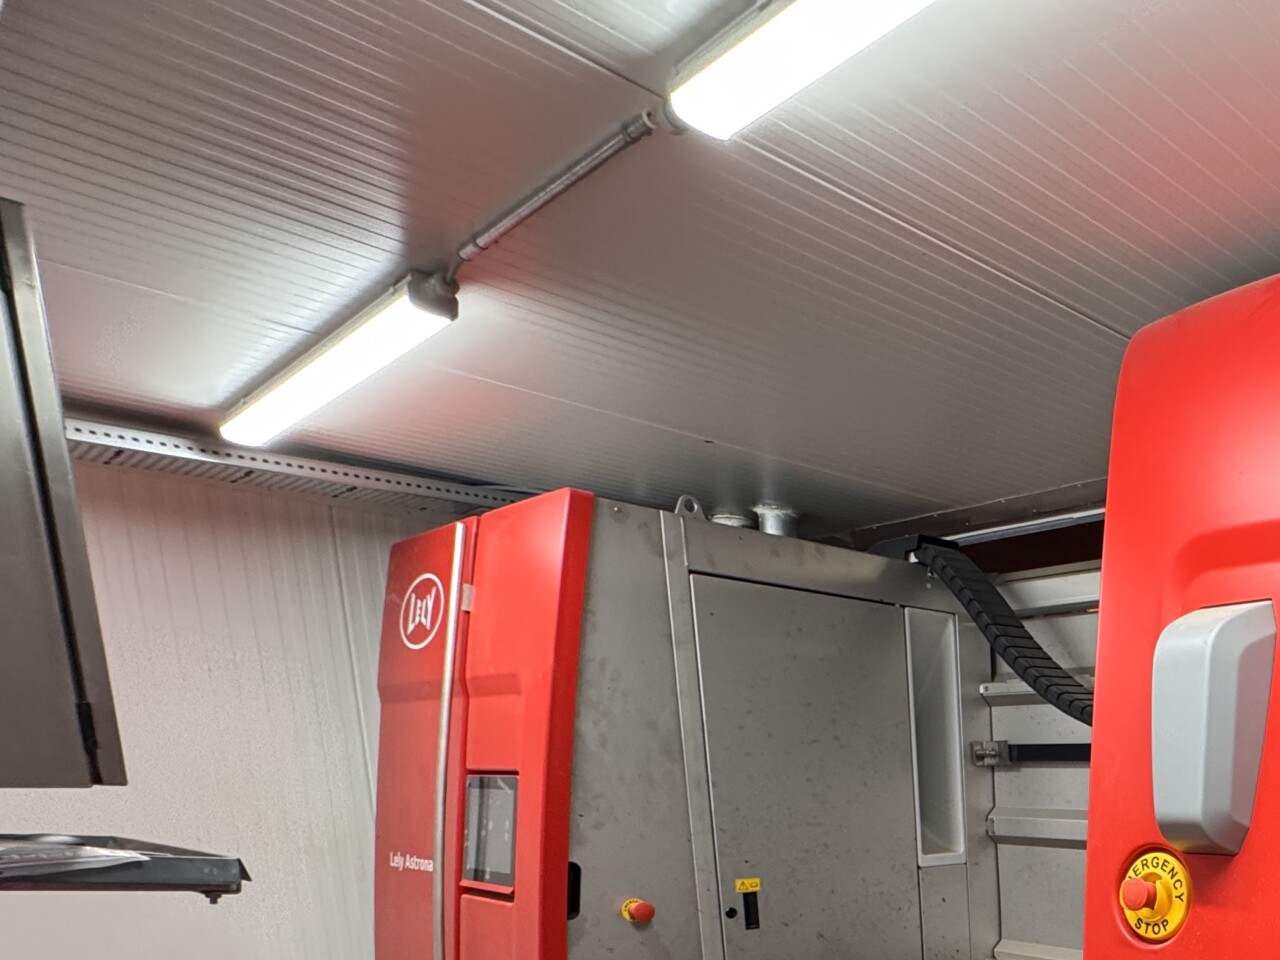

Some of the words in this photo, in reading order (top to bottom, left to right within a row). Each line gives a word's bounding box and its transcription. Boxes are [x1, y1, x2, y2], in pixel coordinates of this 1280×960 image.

[406, 586, 437, 636] LELY
[389, 851, 404, 871] Lely
[405, 853, 434, 872] Astrona
[1128, 856, 1184, 903] ERGENCY
[1134, 917, 1169, 935] STOP
